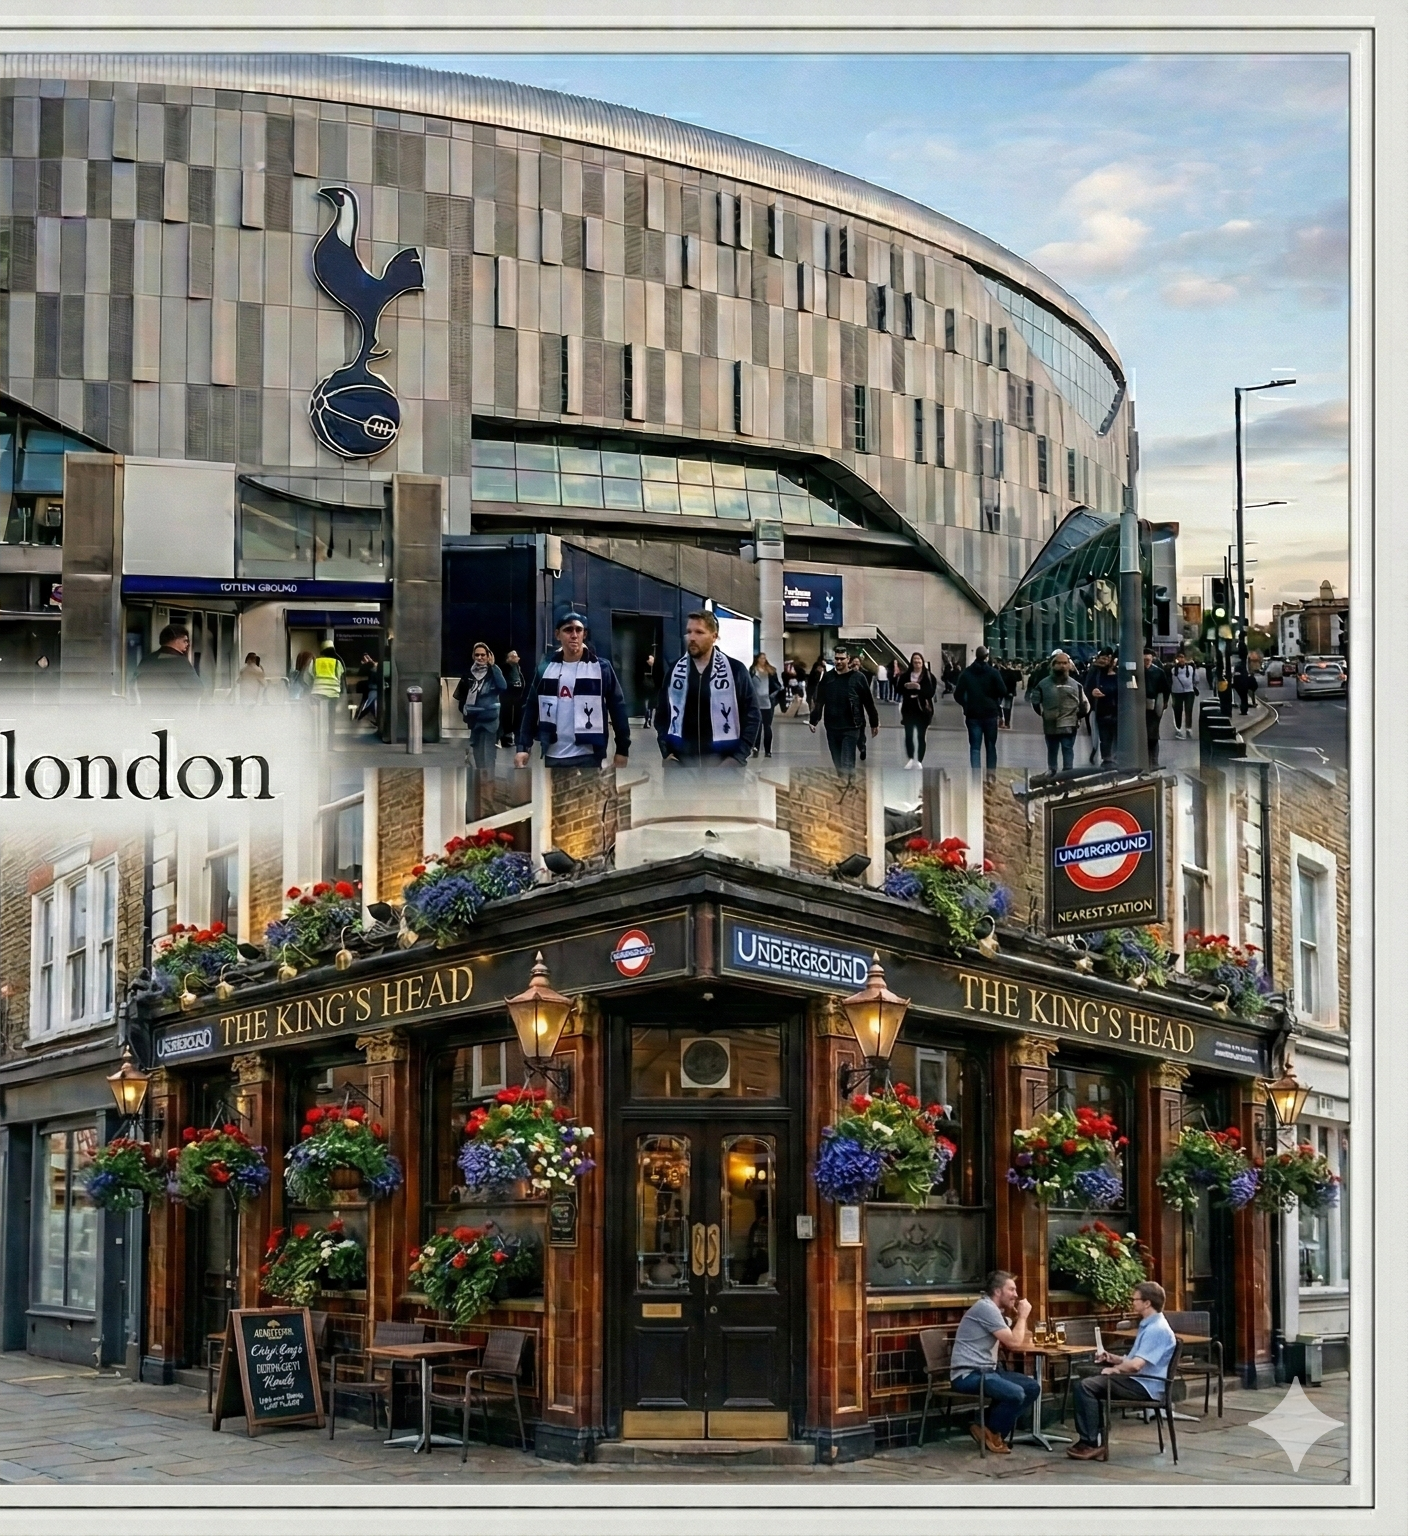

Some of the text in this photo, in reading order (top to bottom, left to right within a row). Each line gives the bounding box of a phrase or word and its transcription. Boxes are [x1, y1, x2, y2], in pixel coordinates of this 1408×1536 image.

[1059, 836, 1148, 862] UNDERGROUND
[1057, 899, 1153, 924] NEAREST STATION
[737, 931, 869, 984] UNDERGROUND
[220, 1009, 269, 1046] THE
[275, 986, 371, 1037] KING'S
[381, 966, 474, 1017] HEAD
[959, 973, 1195, 1054] THE KING'S HEAD
